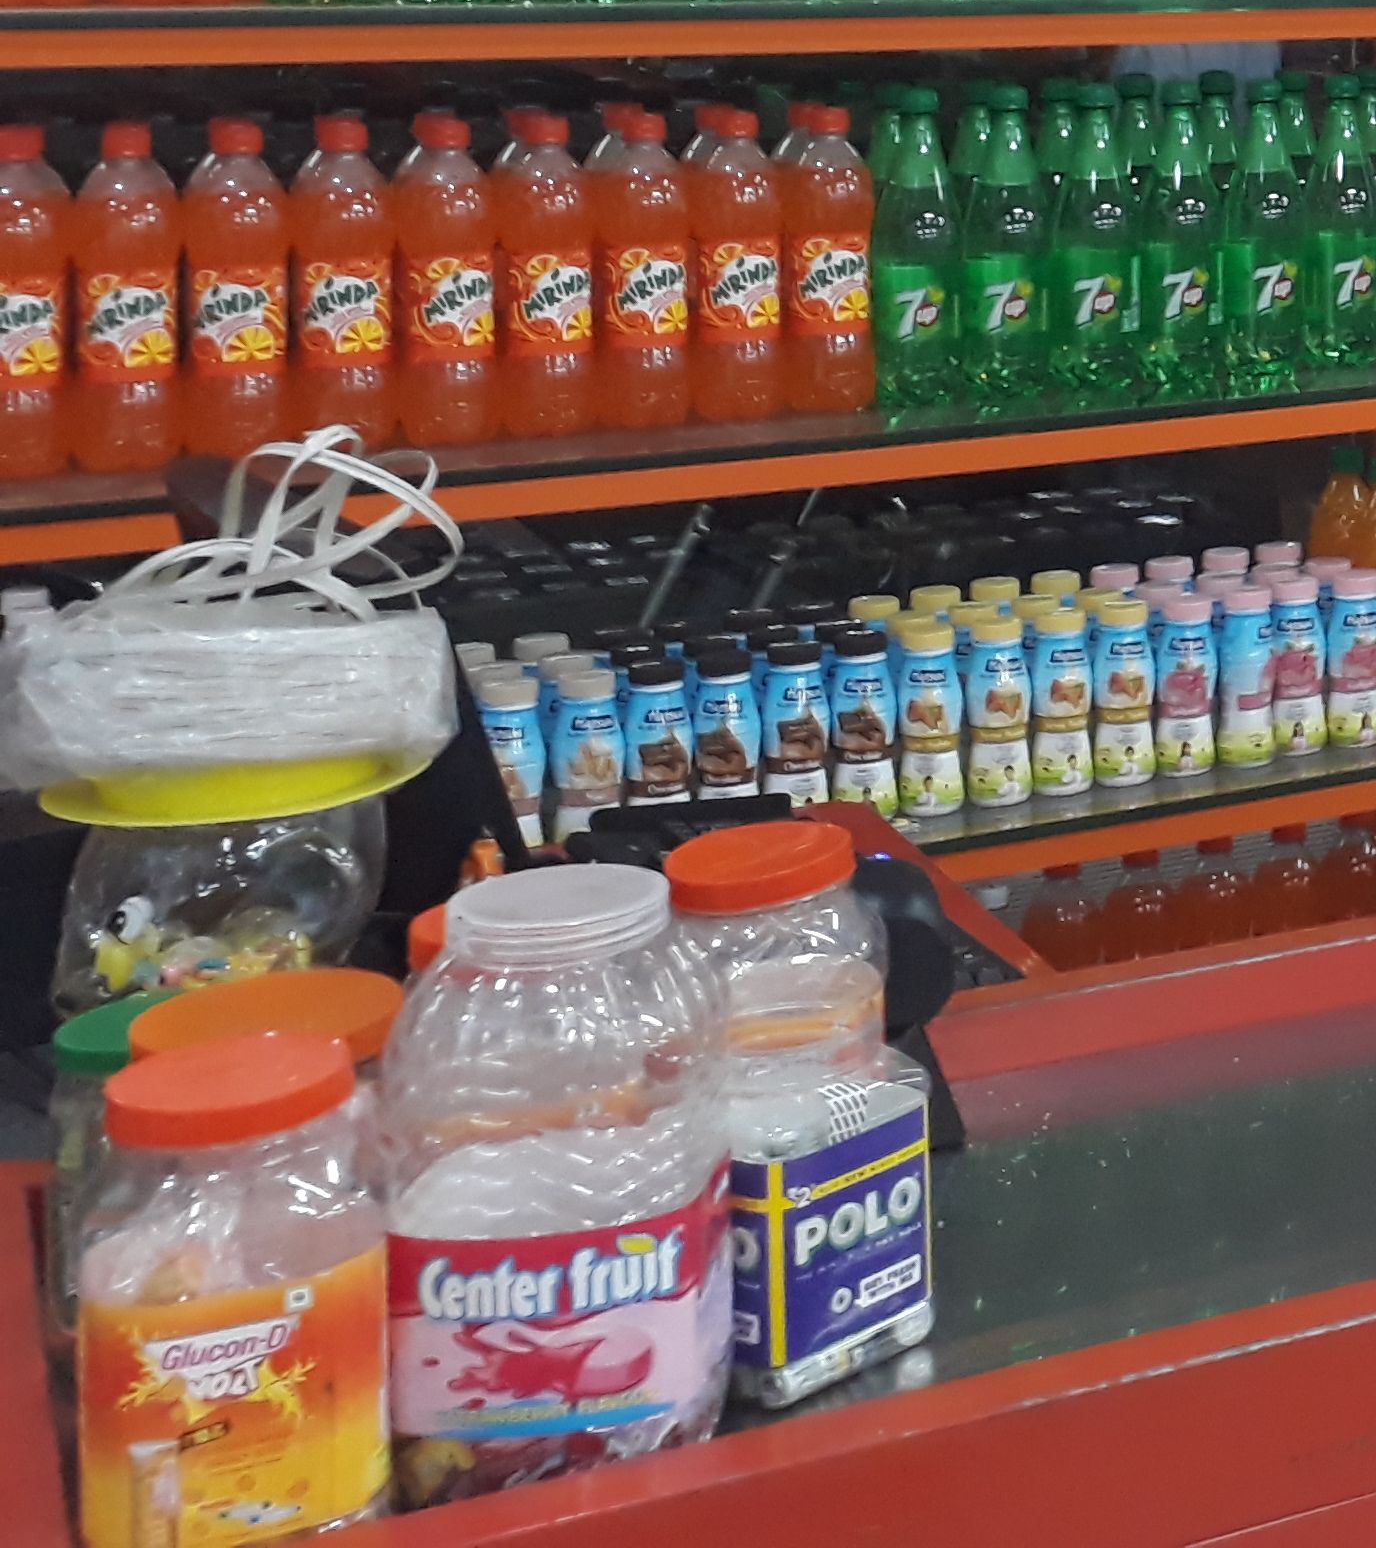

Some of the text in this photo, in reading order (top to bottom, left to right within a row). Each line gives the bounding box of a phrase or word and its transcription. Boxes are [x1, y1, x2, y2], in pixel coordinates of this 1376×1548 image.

[794, 1175, 922, 1268] POLO
[419, 1231, 684, 1321] Center fruit
[161, 1322, 290, 1372] Glucon-D
